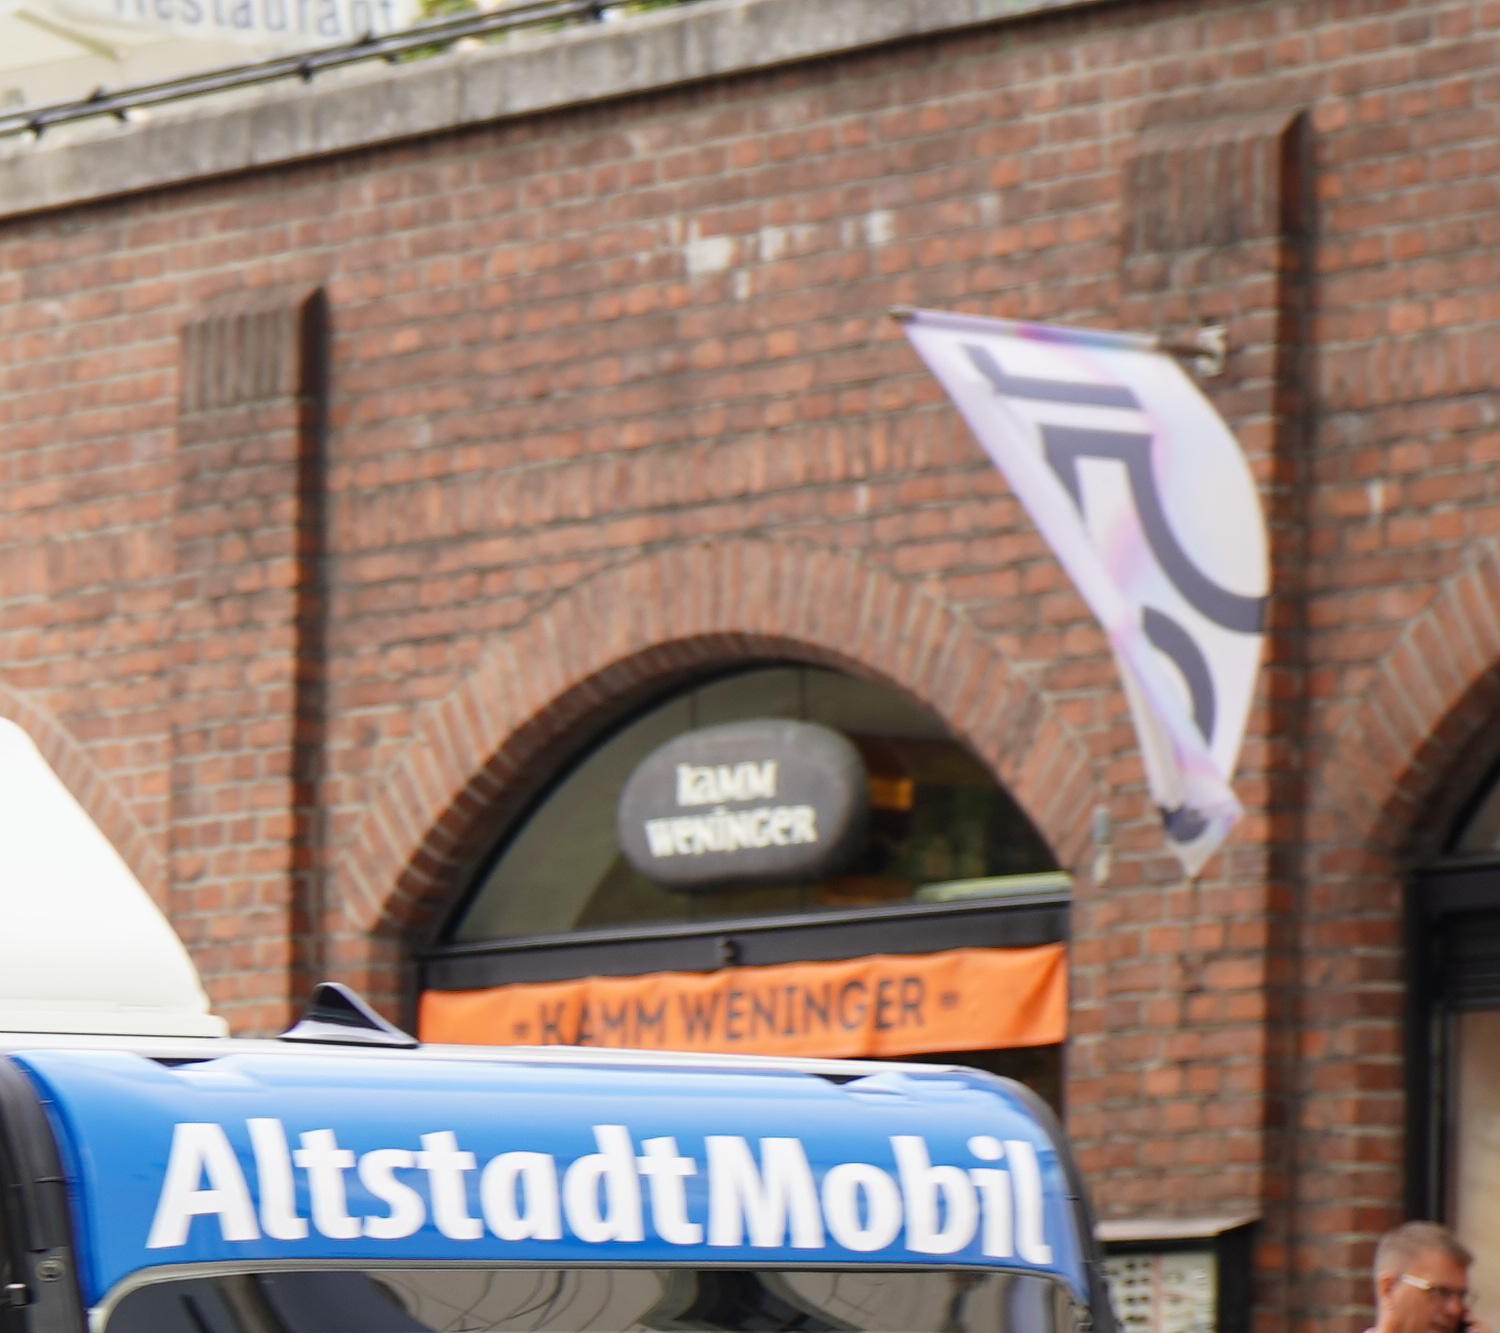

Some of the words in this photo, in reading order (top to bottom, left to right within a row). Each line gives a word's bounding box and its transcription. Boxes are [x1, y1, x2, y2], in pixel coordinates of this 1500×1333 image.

[540, 997, 668, 1047] KAMM
[676, 975, 926, 1042] WENINGER
[145, 1116, 1055, 1265] AltstadtMobil
